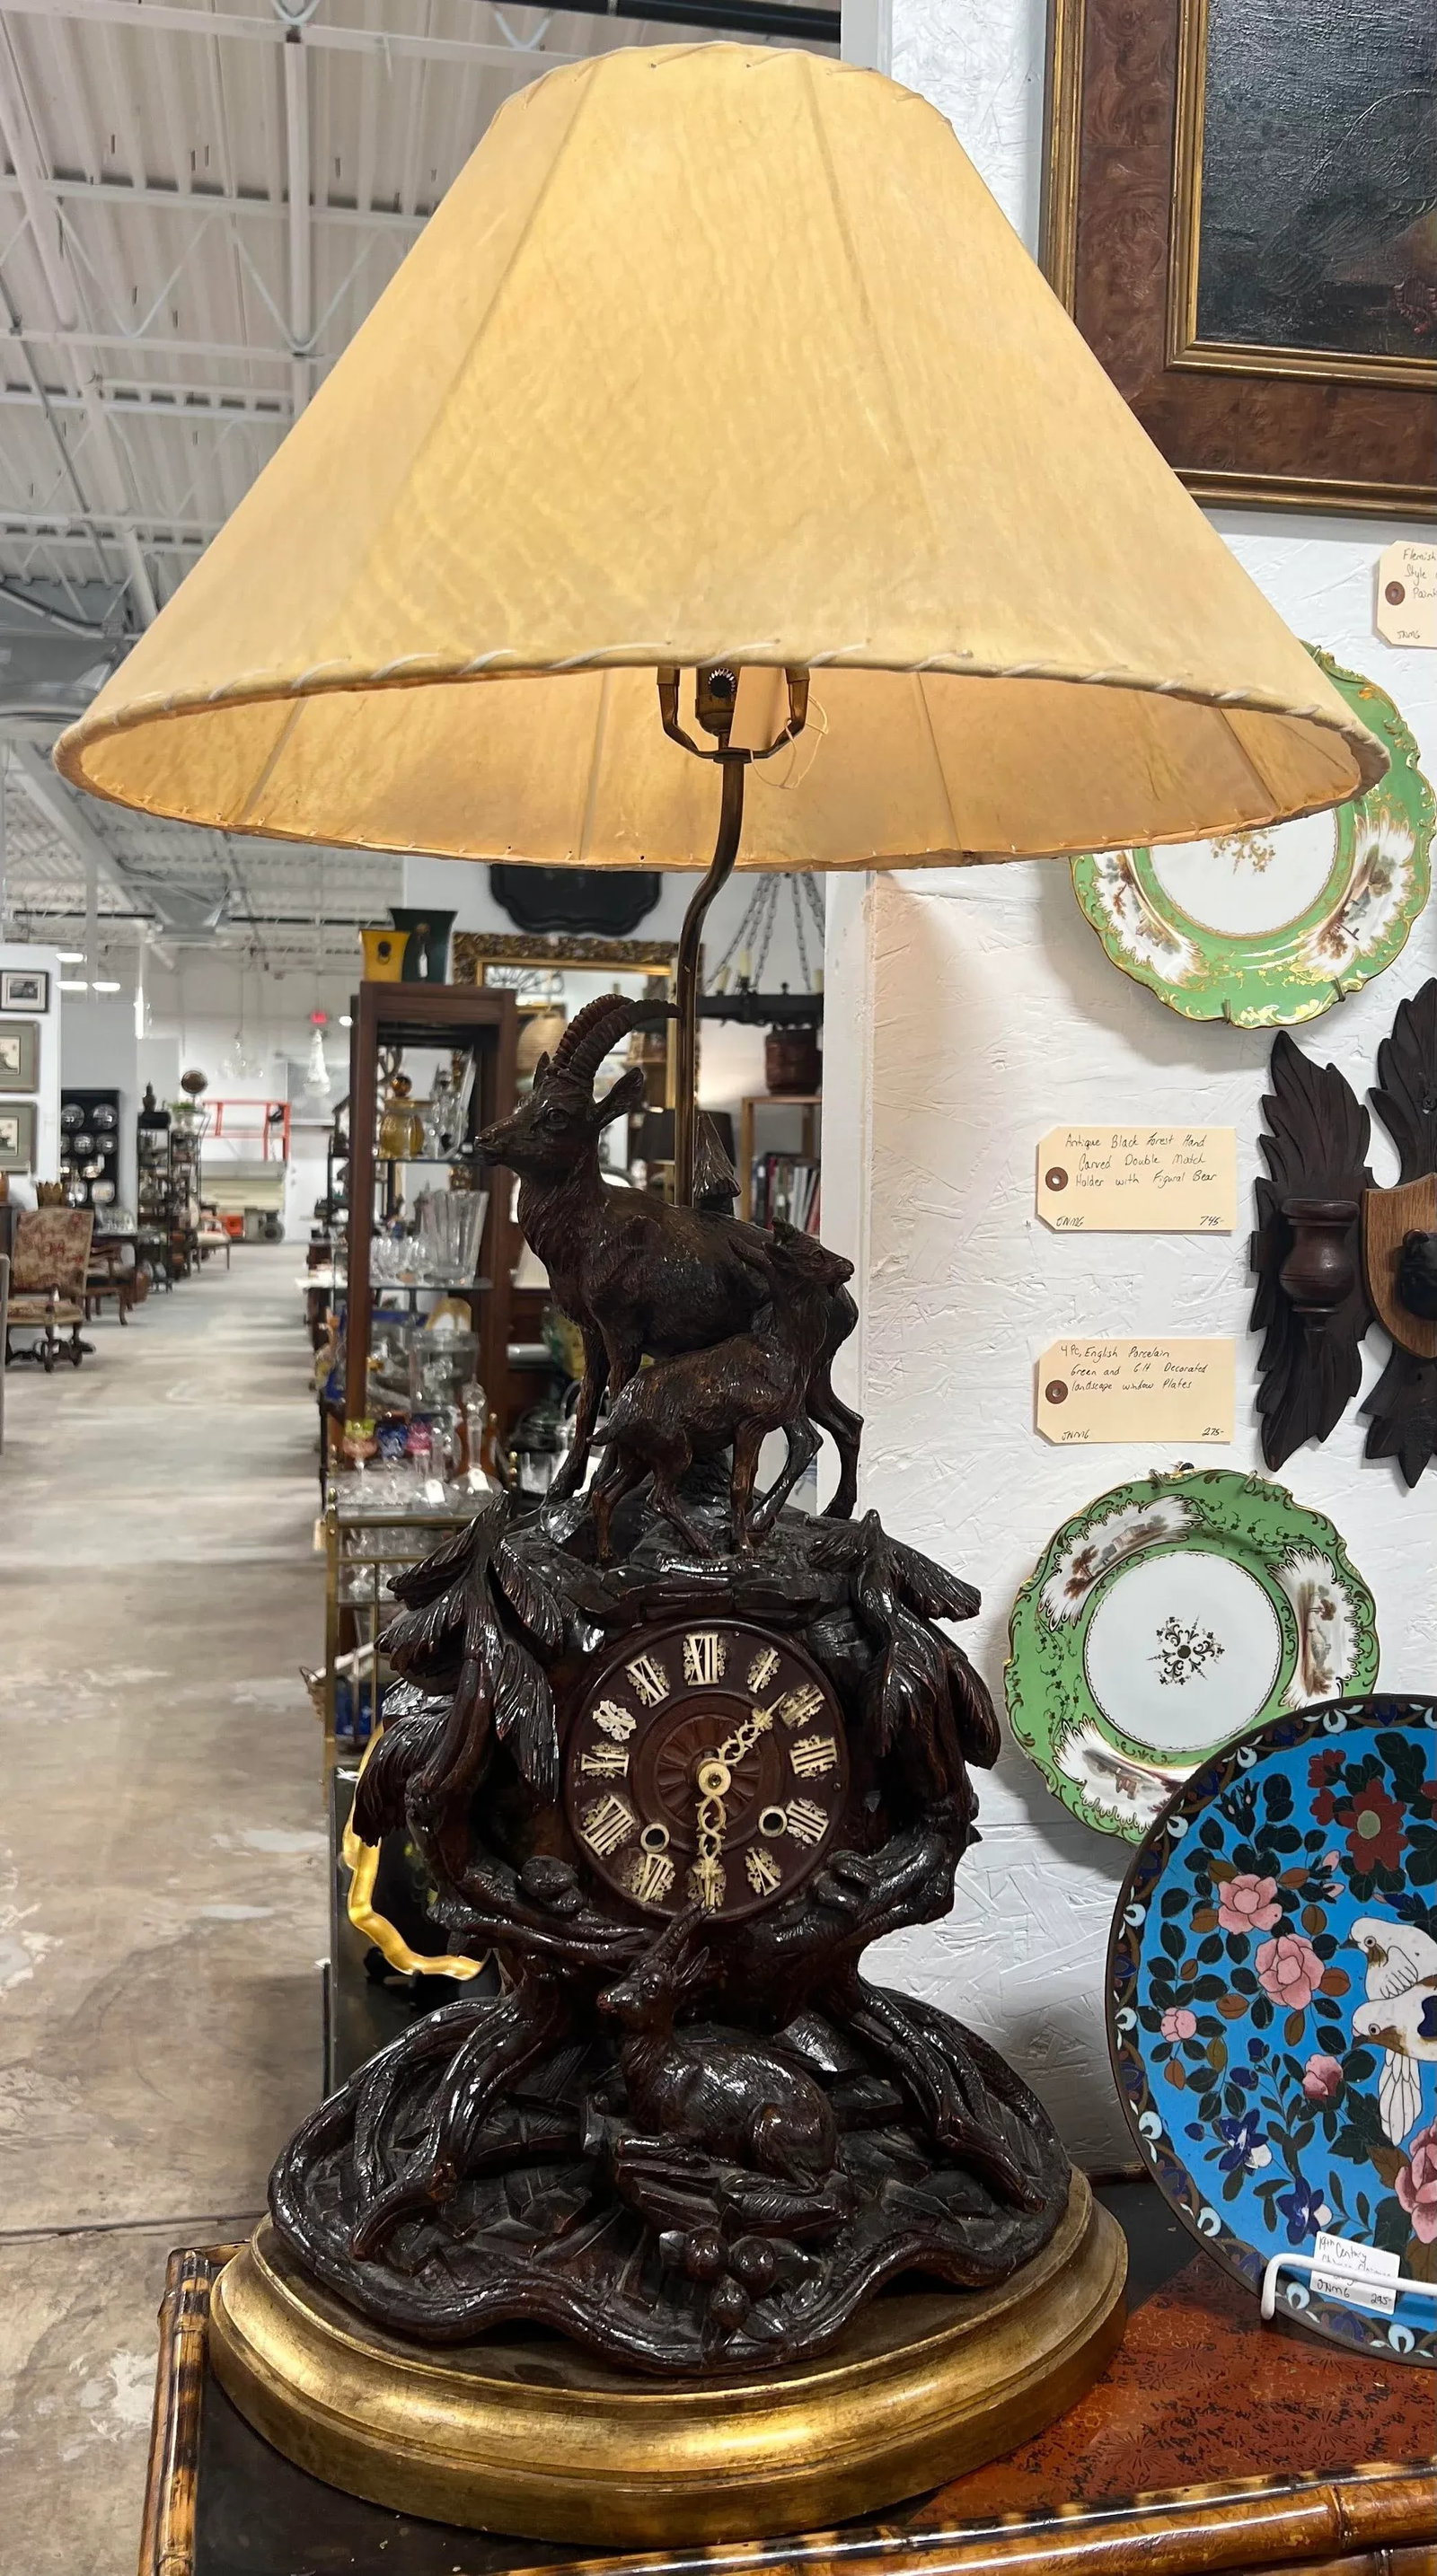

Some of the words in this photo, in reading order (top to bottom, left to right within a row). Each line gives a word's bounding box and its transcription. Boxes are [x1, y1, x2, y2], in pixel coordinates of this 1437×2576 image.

[1403, 548, 1437, 561] Flemish
[1064, 1133, 1101, 1151] Antique
[1111, 1134, 1139, 1148] Black
[1146, 1132, 1174, 1147] Forest
[1182, 1134, 1207, 1147] Hand
[1079, 1153, 1112, 1171] Carved
[1124, 1154, 1160, 1166] Double
[1172, 1153, 1205, 1165] Match
[1076, 1174, 1105, 1187] Holder
[1115, 1175, 1139, 1186] with
[1153, 1170, 1185, 1189] Figural
[1193, 1170, 1217, 1182] Bear
[1061, 1346, 1068, 1358] 4
[1084, 1346, 1118, 1364] English
[1128, 1346, 1170, 1358] Porcelain
[1071, 1363, 1097, 1376] Green
[1103, 1366, 1121, 1376] and
[1133, 1362, 1151, 1373] Glt
[1163, 1362, 1208, 1374] Decorated
[1162, 1380, 1193, 1390] Plates
